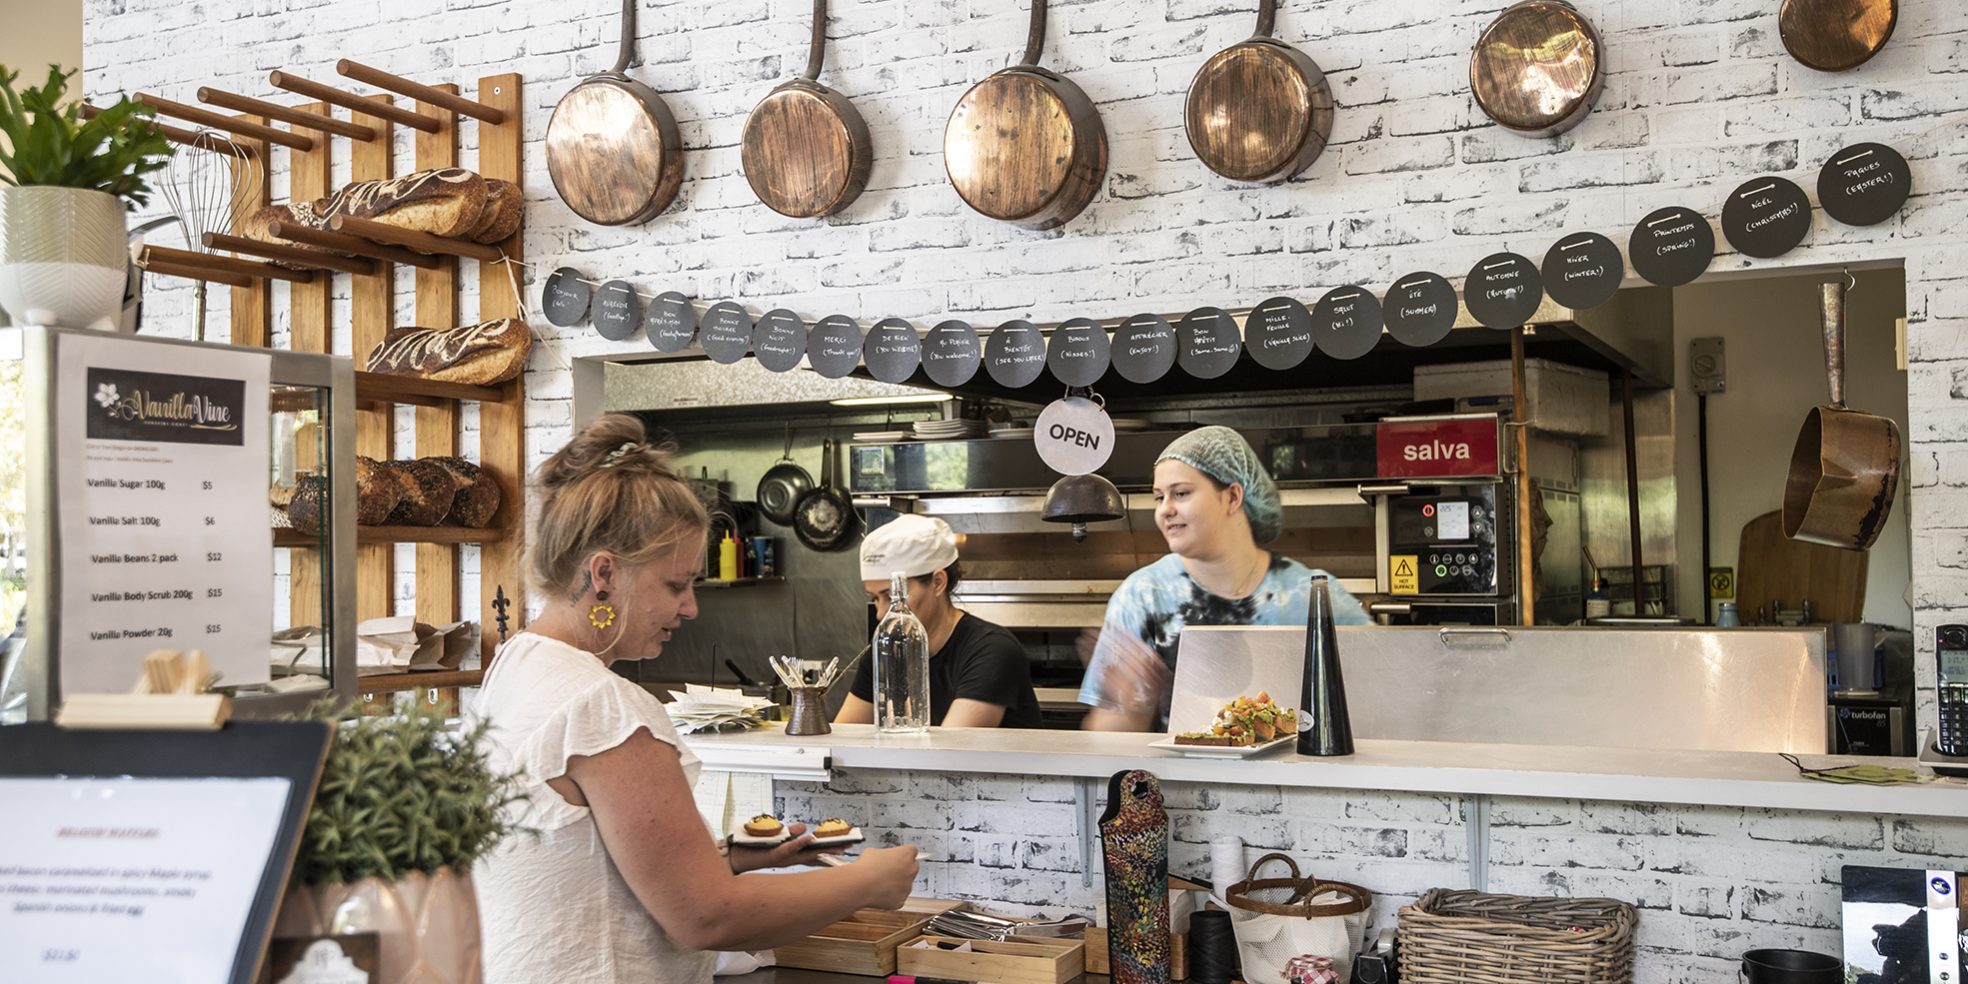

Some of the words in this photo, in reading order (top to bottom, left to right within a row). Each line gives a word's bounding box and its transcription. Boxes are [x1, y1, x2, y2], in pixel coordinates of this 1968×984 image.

[1049, 423, 1100, 451] OPEN
[1403, 439, 1470, 461] salva
[87, 478, 117, 488] Vanilla
[119, 478, 143, 490] Sugar
[146, 479, 166, 491] 100g
[203, 481, 213, 490] $5
[90, 516, 120, 526] Vanilla
[122, 516, 138, 526] Salt
[140, 516, 161, 527] 100g
[205, 516, 216, 526] $6
[92, 554, 122, 564] Vanilla
[124, 554, 150, 563] Beans
[152, 554, 158, 563] 2
[159, 553, 179, 564] pack
[207, 552, 222, 562] $12
[92, 592, 122, 602] Vanilla
[124, 591, 146, 602] Body
[148, 590, 172, 600] Scrub
[173, 590, 193, 601] 200g
[208, 588, 223, 598] $15
[91, 631, 121, 641] Vanilla
[123, 628, 156, 639] Powder
[158, 628, 173, 638] 20g
[206, 624, 222, 634] $15
[1851, 711, 1886, 720] turbofan
